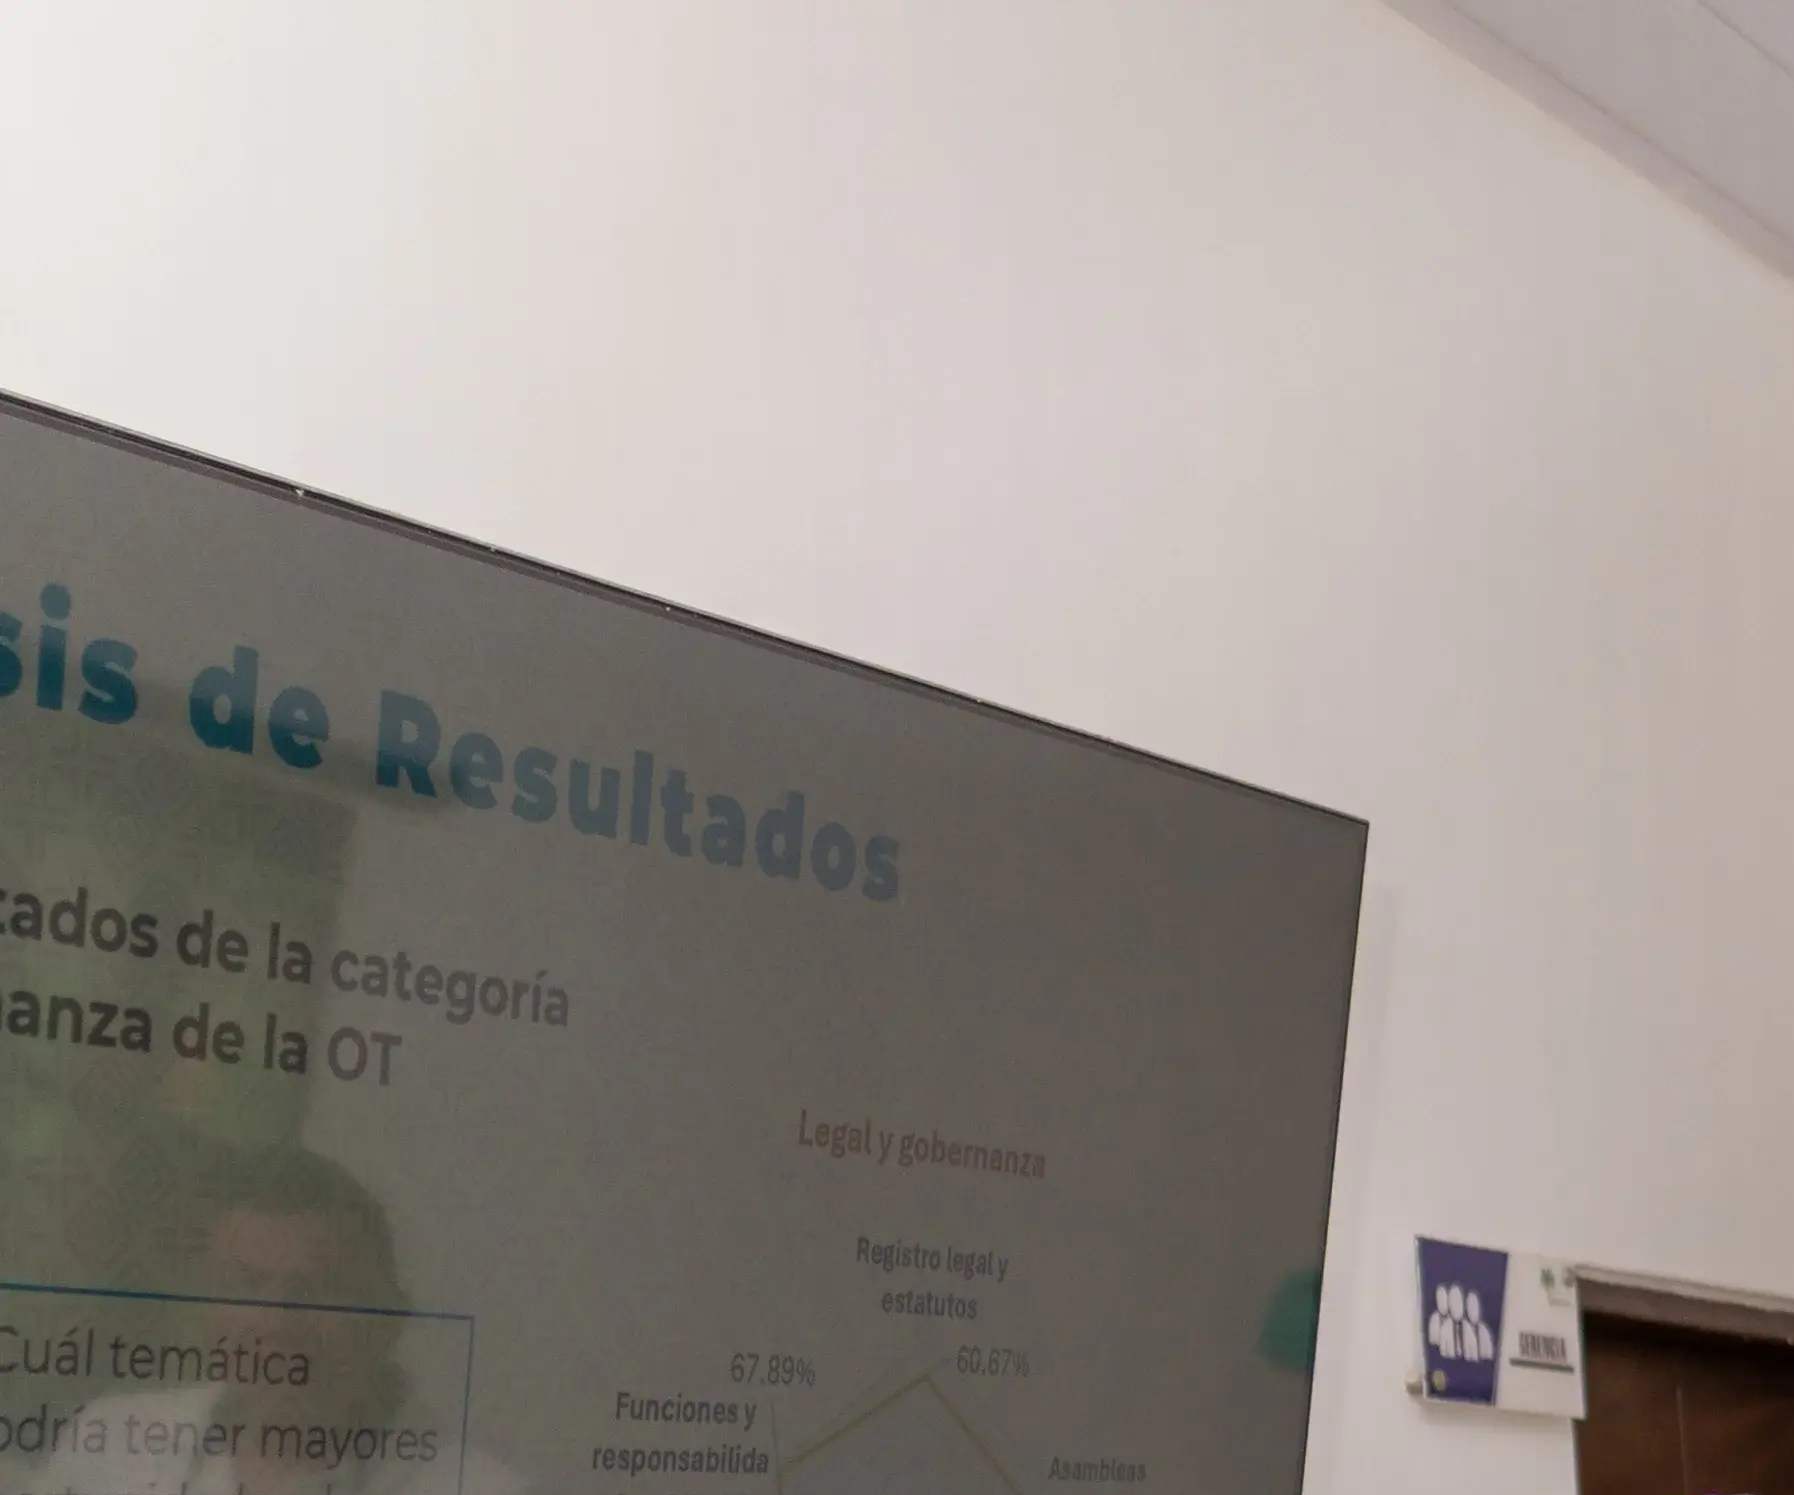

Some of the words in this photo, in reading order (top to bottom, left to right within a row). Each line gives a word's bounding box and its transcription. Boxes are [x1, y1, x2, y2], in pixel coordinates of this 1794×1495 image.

[188, 644, 330, 770] de
[375, 687, 901, 904] Resultados
[0, 885, 160, 959] ados
[176, 909, 250, 974] de
[268, 921, 315, 985] la
[331, 948, 571, 1028] categoría
[0, 988, 153, 1055] anza
[172, 1003, 246, 1065] de
[263, 1012, 309, 1076] la
[327, 1026, 403, 1086] OT
[796, 1109, 872, 1158] Legal
[879, 1129, 894, 1160] y
[899, 1129, 1048, 1181] gobernanza
[856, 1236, 941, 1274] Registro
[946, 1246, 993, 1281] legal
[995, 1254, 1010, 1285] y
[880, 1290, 979, 1321] estatutos
[110, 1334, 313, 1388] temática
[729, 1352, 817, 1388] 67.89%
[615, 1391, 738, 1424] Funciones
[743, 1402, 757, 1432] y
[124, 1412, 247, 1460] tener
[259, 1427, 439, 1470] mayores
[592, 1443, 769, 1477] responsabilida
[1048, 1456, 1147, 1483] Asambleas
